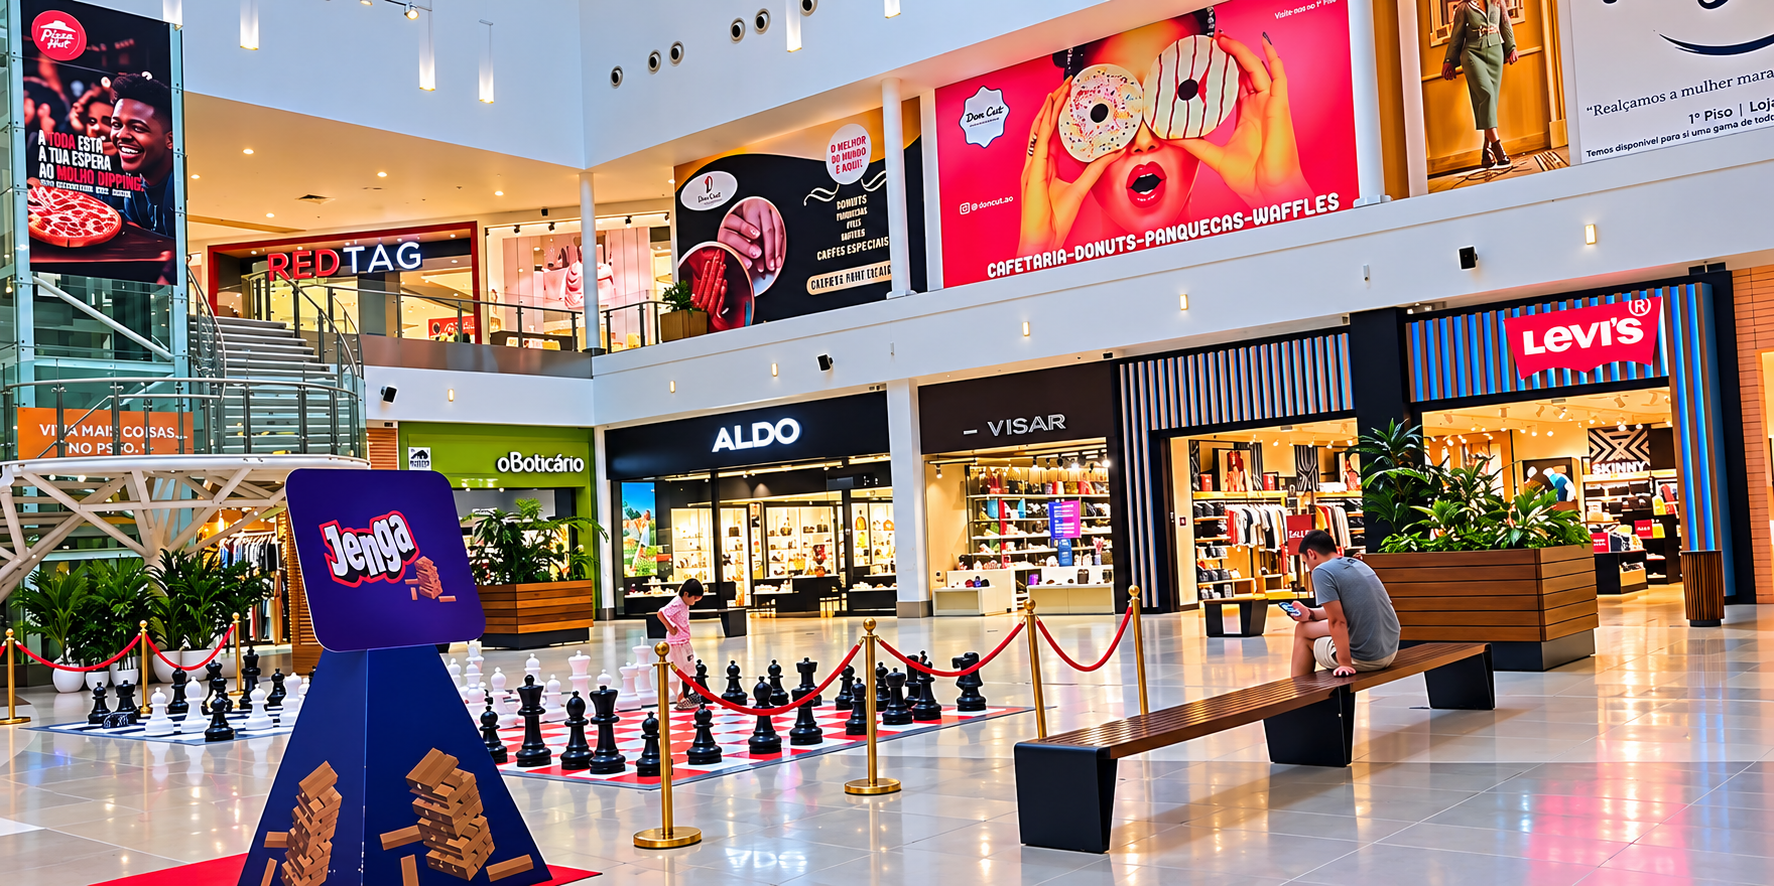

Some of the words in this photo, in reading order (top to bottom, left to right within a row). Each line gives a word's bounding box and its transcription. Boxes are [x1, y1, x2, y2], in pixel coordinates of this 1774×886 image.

[40, 29, 74, 42] Pizza
[47, 38, 71, 50] Hut
[1669, 90, 1678, 100] a
[1680, 78, 1733, 98] mulher
[966, 112, 984, 122] Don
[1704, 108, 1733, 122] Piso
[38, 129, 46, 146] A
[48, 132, 76, 150] TODA
[830, 144, 836, 153] O
[838, 136, 866, 151] MELHOR
[1586, 147, 1614, 158] Temos
[1660, 134, 1680, 144] para
[1692, 128, 1711, 137] uma
[1713, 122, 1738, 134] gama
[48, 147, 70, 165] TUA
[72, 150, 112, 171] ESPERA
[39, 162, 54, 179] AO
[56, 164, 94, 184] MOLHO
[846, 236, 890, 255] ESPECIAIS
[711, 418, 801, 452] ALDO
[987, 414, 1066, 437] VISAR
[68, 442, 92, 454] NO
[1592, 461, 1650, 474] SKINNY
[321, 512, 417, 582] Jenga
